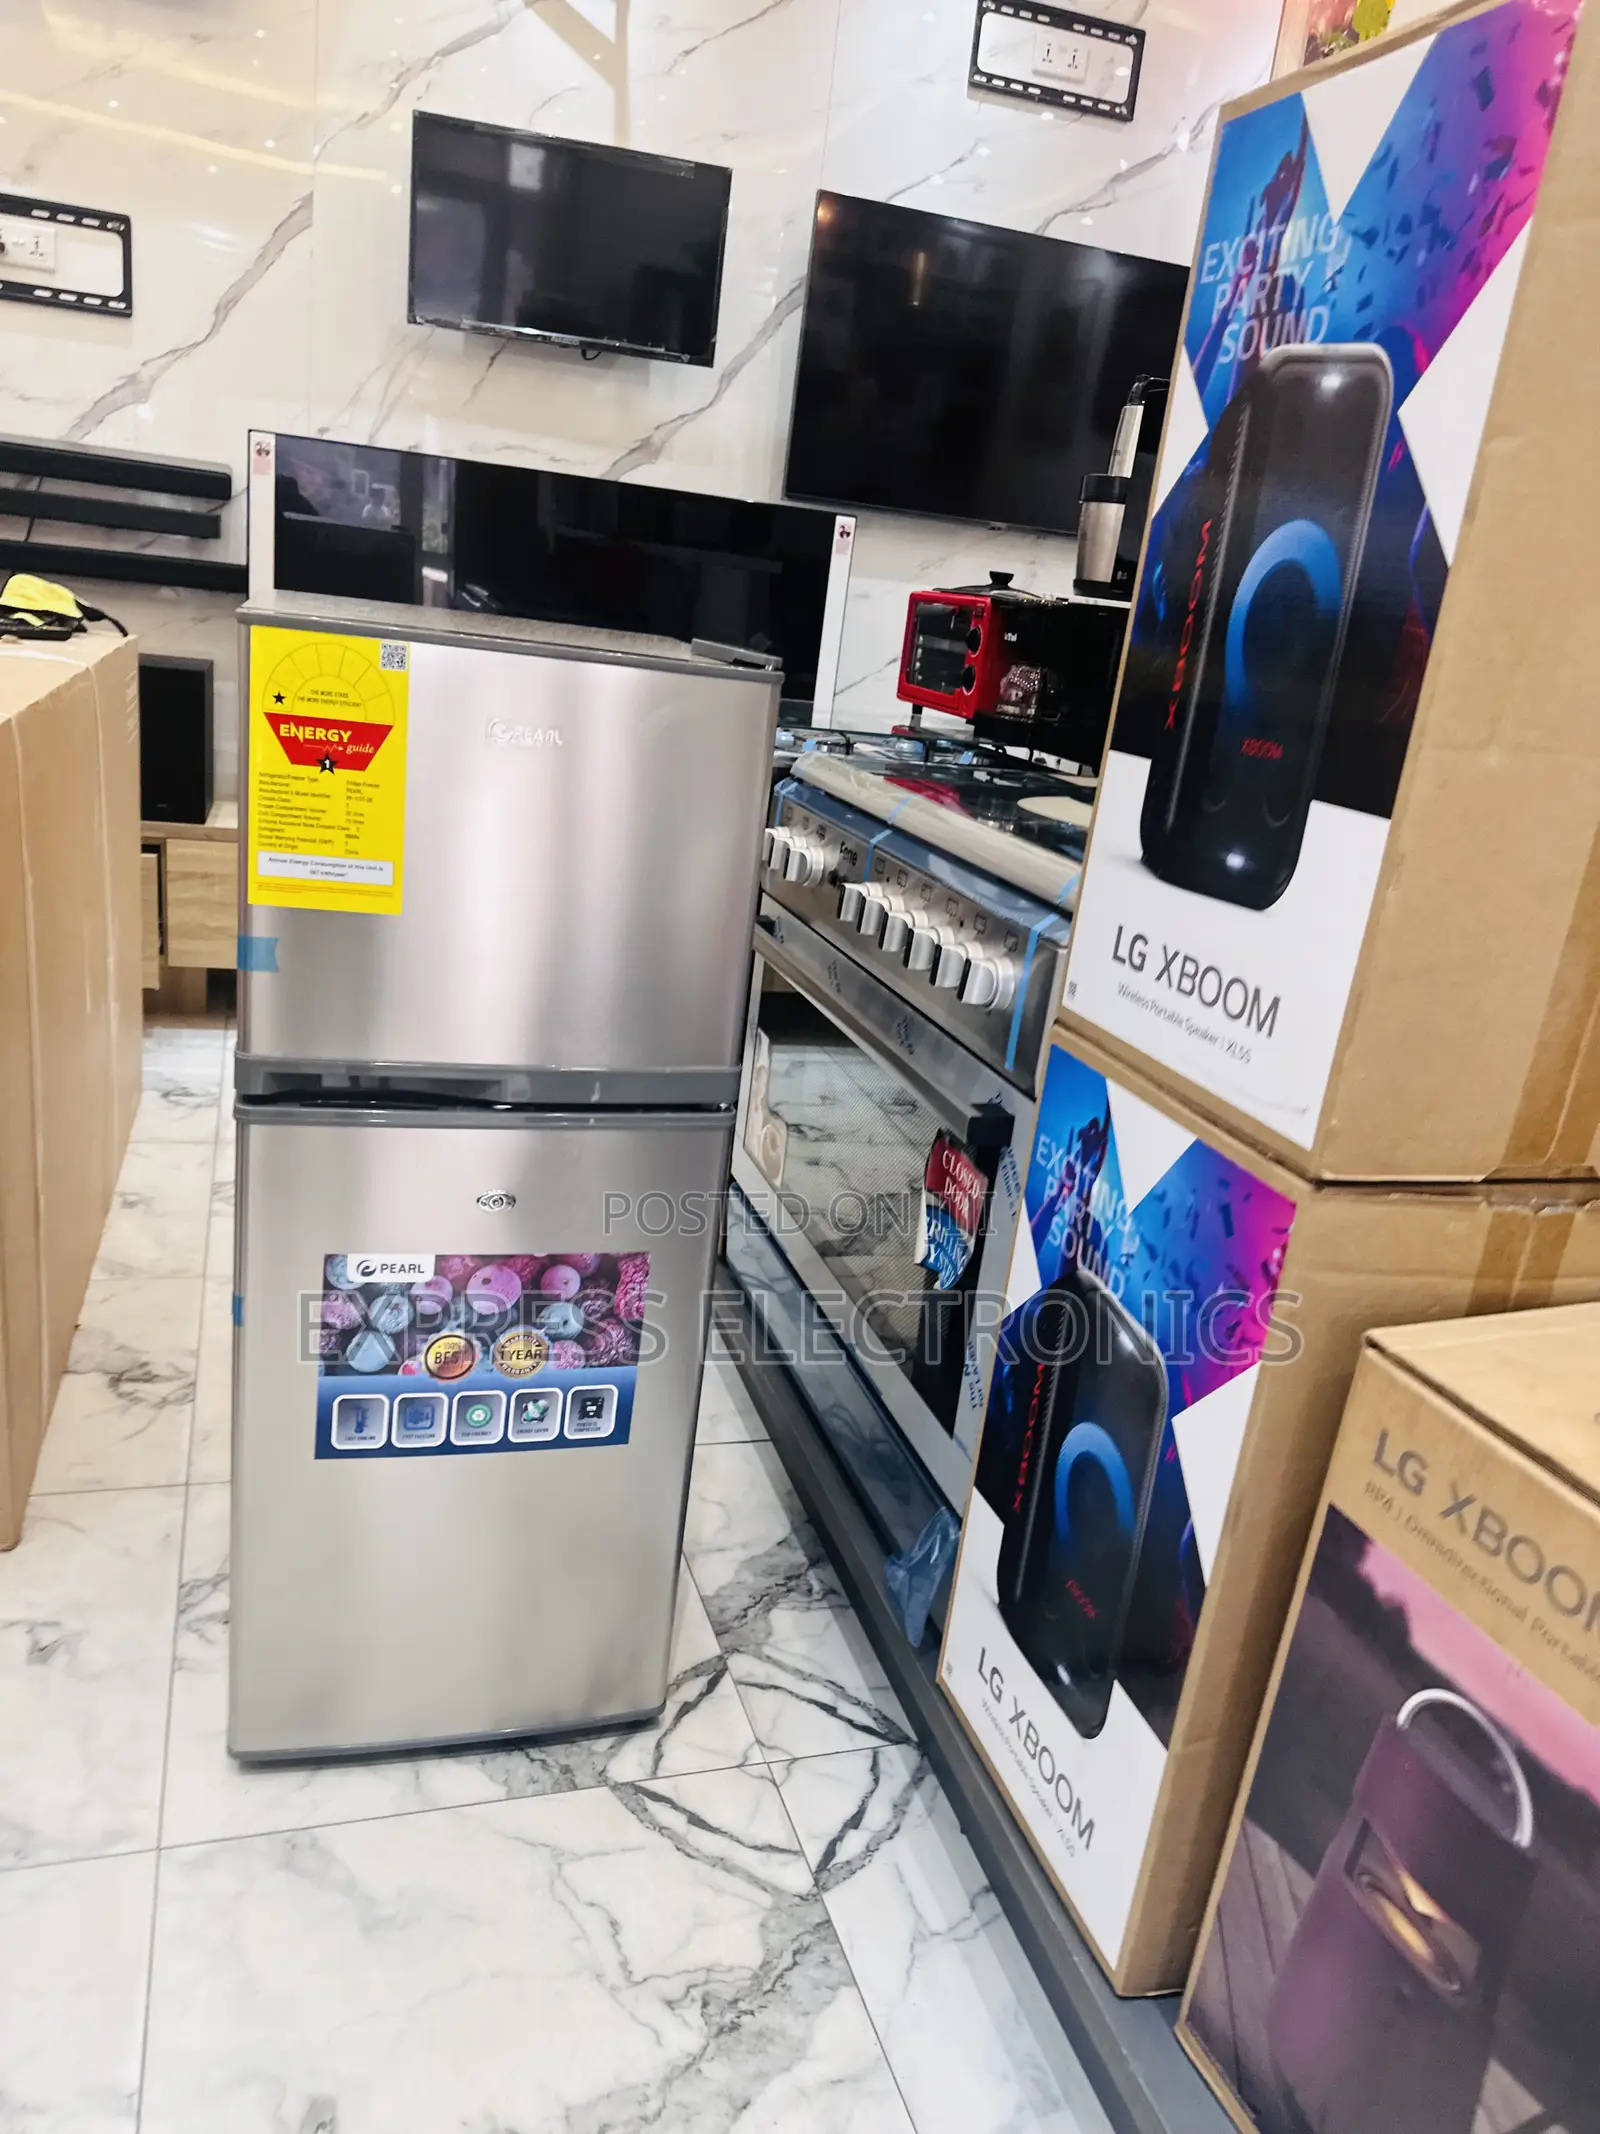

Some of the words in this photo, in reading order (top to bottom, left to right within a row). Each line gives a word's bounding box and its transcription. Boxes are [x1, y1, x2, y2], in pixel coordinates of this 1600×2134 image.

[1200, 212, 1340, 284] EXCITING
[1212, 261, 1314, 324] PARTY
[1218, 306, 1329, 363] SOUND
[280, 720, 352, 743] ENERGY
[346, 744, 375, 755] guide
[1112, 925, 1149, 972] LG
[1154, 944, 1281, 1038] XBOOM
[1185, 1017, 1219, 1046] Speaker
[942, 1150, 980, 1200] CLOSED
[944, 1176, 969, 1220] DOOR
[1036, 1134, 1131, 1230] EXCITING
[1044, 1175, 1114, 1250] PARTY
[380, 1263, 425, 1275] PEARL
[1050, 1214, 1125, 1300] SOUND
[501, 1362, 539, 1375] WARRANTY
[508, 1350, 542, 1360] YEAR
[1373, 1429, 1428, 1496] LG
[978, 1647, 1004, 1704] LG
[1008, 1695, 1095, 1851] XBOOM
